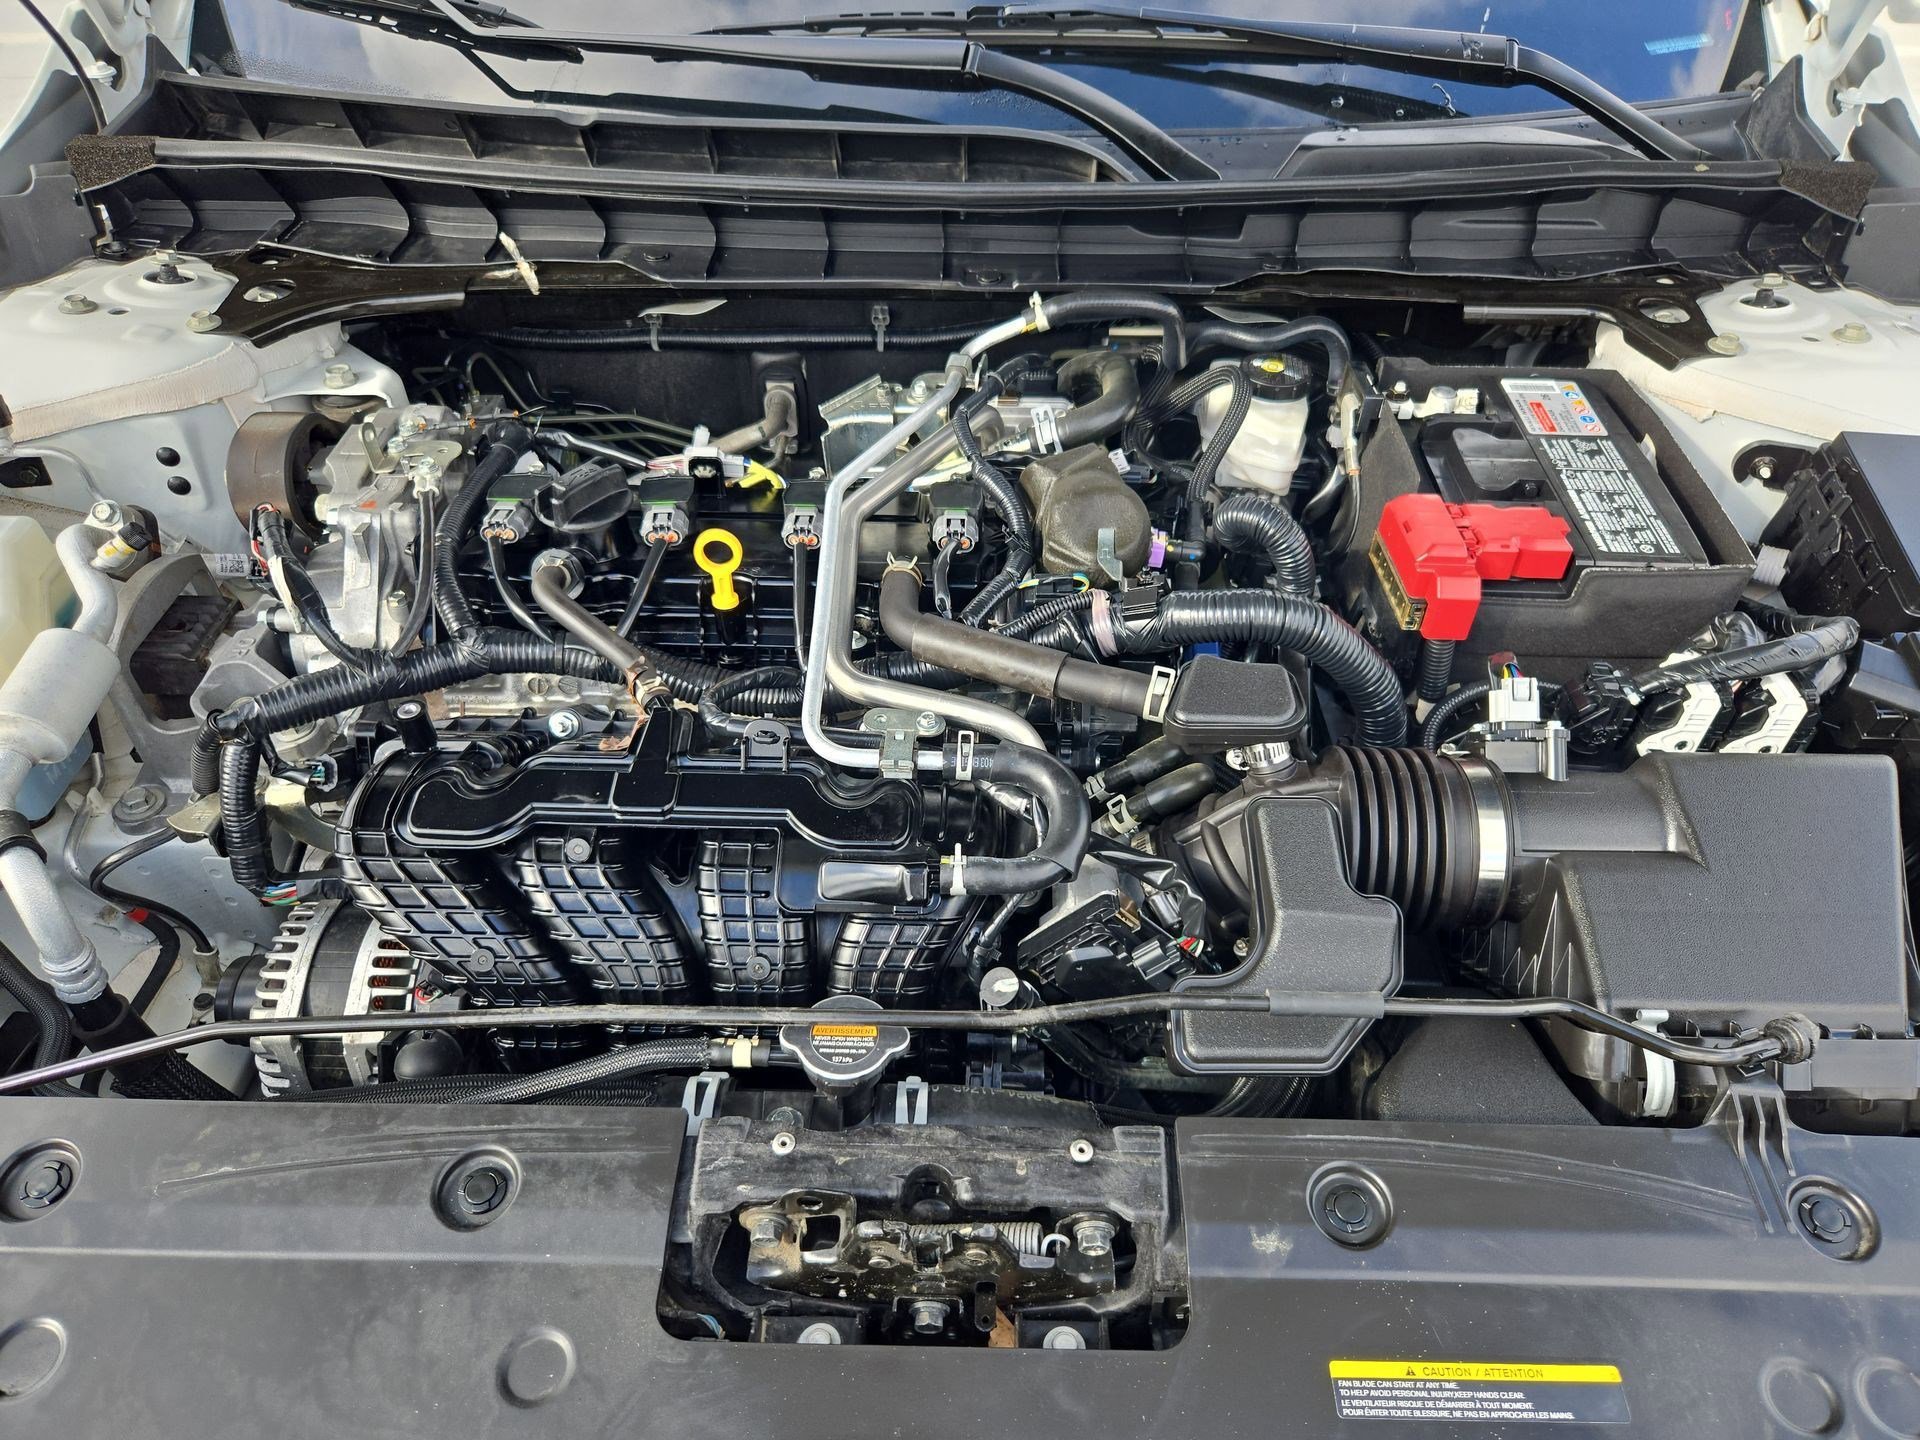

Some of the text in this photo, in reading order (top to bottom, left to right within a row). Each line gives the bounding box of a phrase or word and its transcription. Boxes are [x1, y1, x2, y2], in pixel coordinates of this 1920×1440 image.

[815, 1027, 875, 1035] AVERTISSEMENT
[1422, 1366, 1471, 1377] CAUTION
[1484, 1367, 1544, 1378] ATTENTION
[1352, 1380, 1376, 1388] BLADE
[1392, 1389, 1430, 1397] PERSONAL
[1473, 1391, 1499, 1399] HANDS
[1397, 1400, 1424, 1408] RISQUE
[1436, 1399, 1475, 1409] DÉMARRER
[1475, 1399, 1482, 1409] À
[1482, 1401, 1501, 1409] TOUT
[1502, 1402, 1535, 1410] MOMENT.
[1343, 1408, 1364, 1416] POUR
[1364, 1407, 1389, 1416] ÉVITER
[1389, 1409, 1413, 1417] TOUTE
[1413, 1409, 1453, 1418] BLESSURE,
[1453, 1410, 1464, 1418] NE
[1464, 1410, 1478, 1418] PAS
[1490, 1411, 1536, 1419] APPROCHER
[1536, 1411, 1550, 1419] LES
